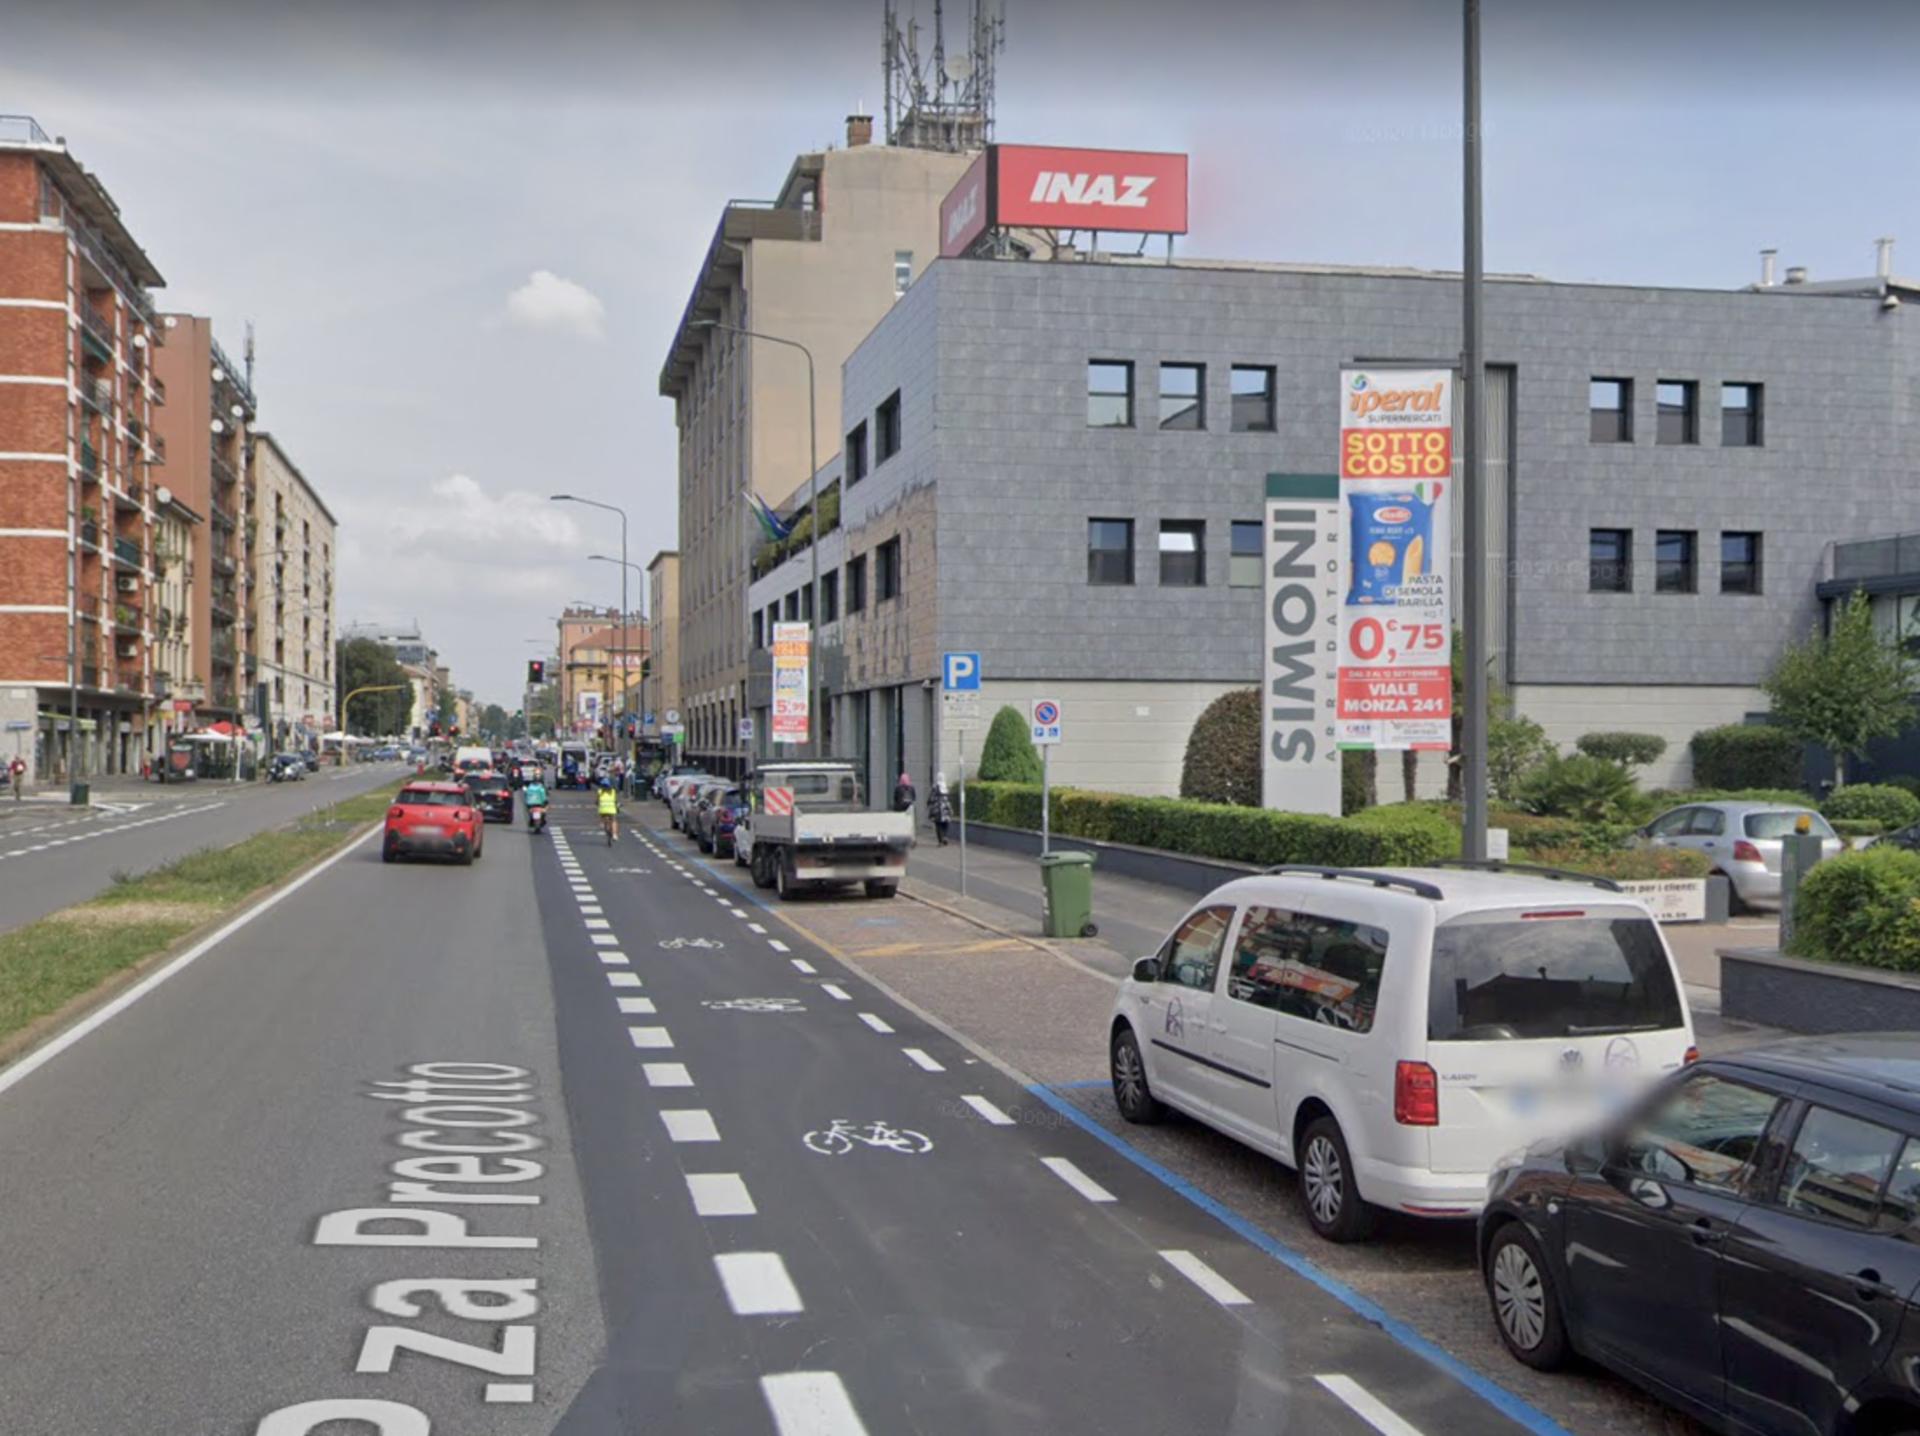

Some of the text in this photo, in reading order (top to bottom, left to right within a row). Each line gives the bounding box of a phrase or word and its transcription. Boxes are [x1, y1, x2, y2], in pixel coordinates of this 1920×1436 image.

[1030, 171, 1157, 207] INAZ
[1350, 382, 1444, 418] iperal
[1368, 413, 1442, 424] SUPERMERCATI
[1347, 432, 1445, 454] SOTTO
[1347, 454, 1445, 475] COSTO
[1408, 575, 1443, 584] PASTA
[1385, 586, 1443, 596] DI SEMOLA
[1398, 597, 1443, 607] BARILLA
[1272, 509, 1316, 763] SIMONI
[1326, 508, 1339, 761] ARREDATORI
[948, 656, 974, 687] P
[1368, 683, 1419, 696] VIALE
[1344, 699, 1444, 712] MONZA 241
[313, 1061, 545, 1248] Precotto
